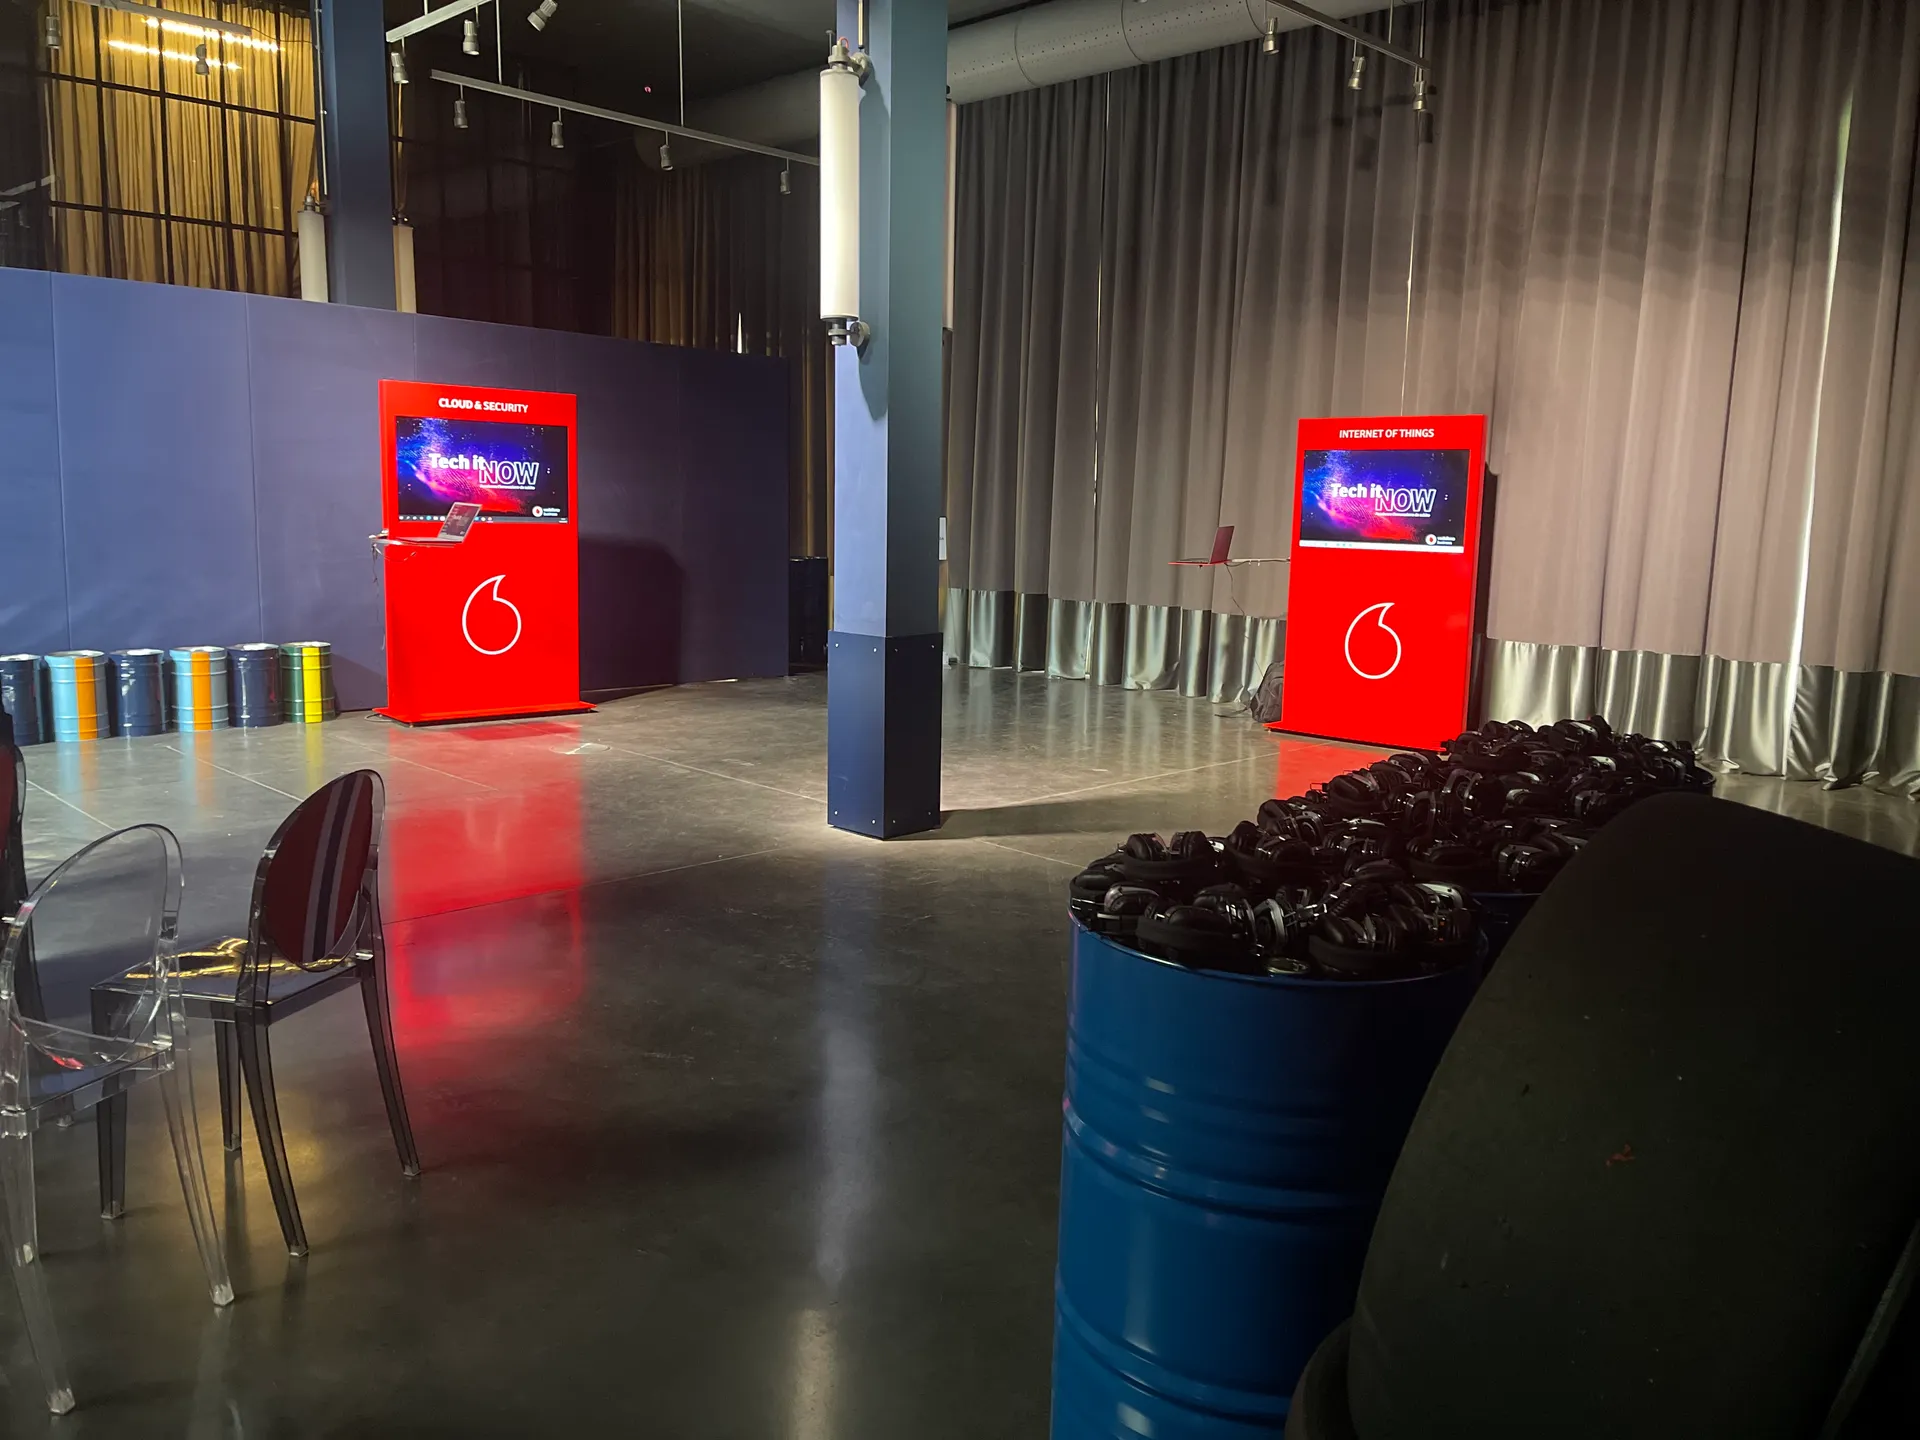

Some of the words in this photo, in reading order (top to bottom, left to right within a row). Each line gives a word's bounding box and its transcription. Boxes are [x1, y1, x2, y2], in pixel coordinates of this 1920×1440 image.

[438, 397, 474, 410] CLOUD
[474, 400, 483, 410] &
[483, 401, 529, 414] SECURITY
[1339, 429, 1384, 439] INTERNET
[1384, 429, 1399, 438] OF
[1399, 428, 1435, 438] THINGS
[428, 453, 470, 470] Tech
[472, 454, 486, 471] it
[478, 460, 540, 485] NOW
[1330, 483, 1368, 499] Tech
[1369, 483, 1383, 499] it
[1374, 488, 1437, 513] NOW
